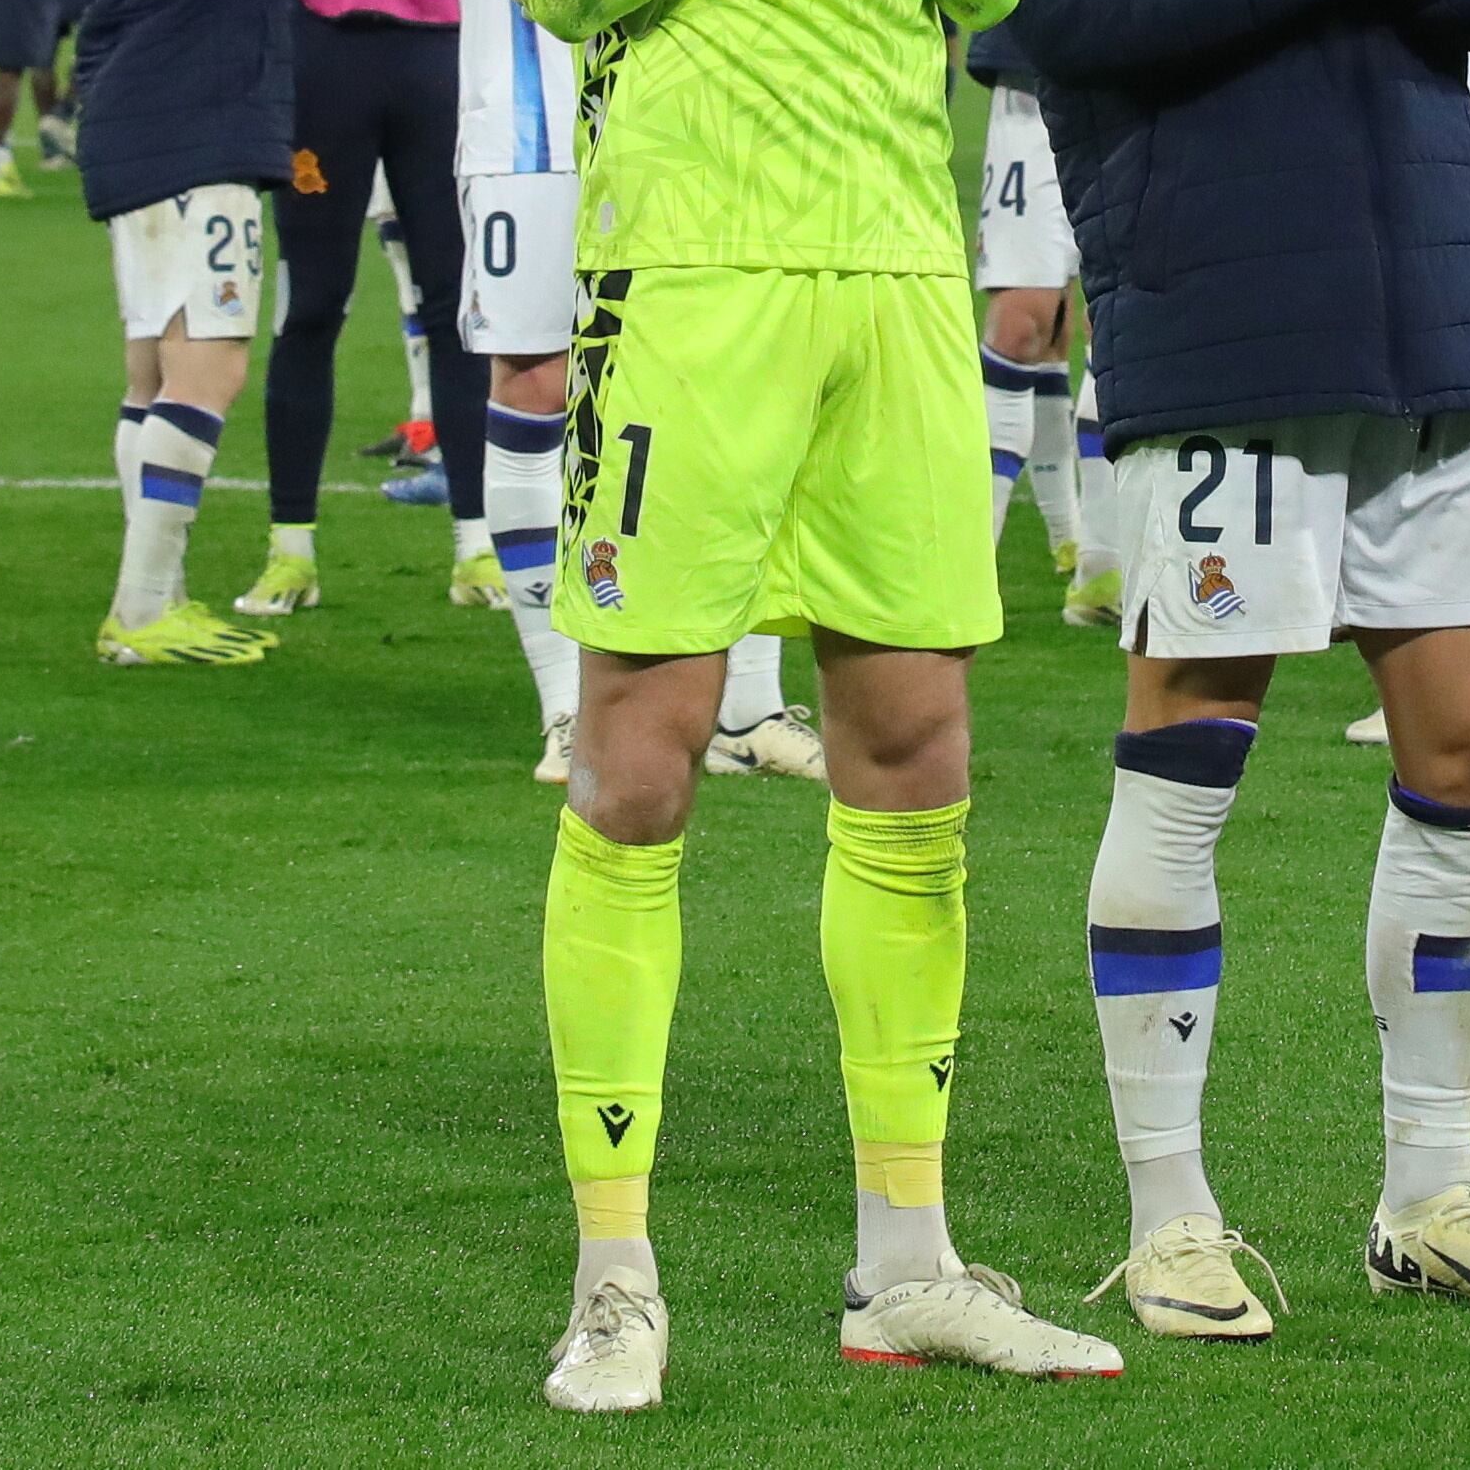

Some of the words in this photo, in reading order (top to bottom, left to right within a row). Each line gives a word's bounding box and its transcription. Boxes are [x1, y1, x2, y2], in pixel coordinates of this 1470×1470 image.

[205, 214, 261, 276] 25
[618, 423, 652, 537] 1
[1177, 434, 1274, 545] 21
[885, 1290, 911, 1305] COPA
